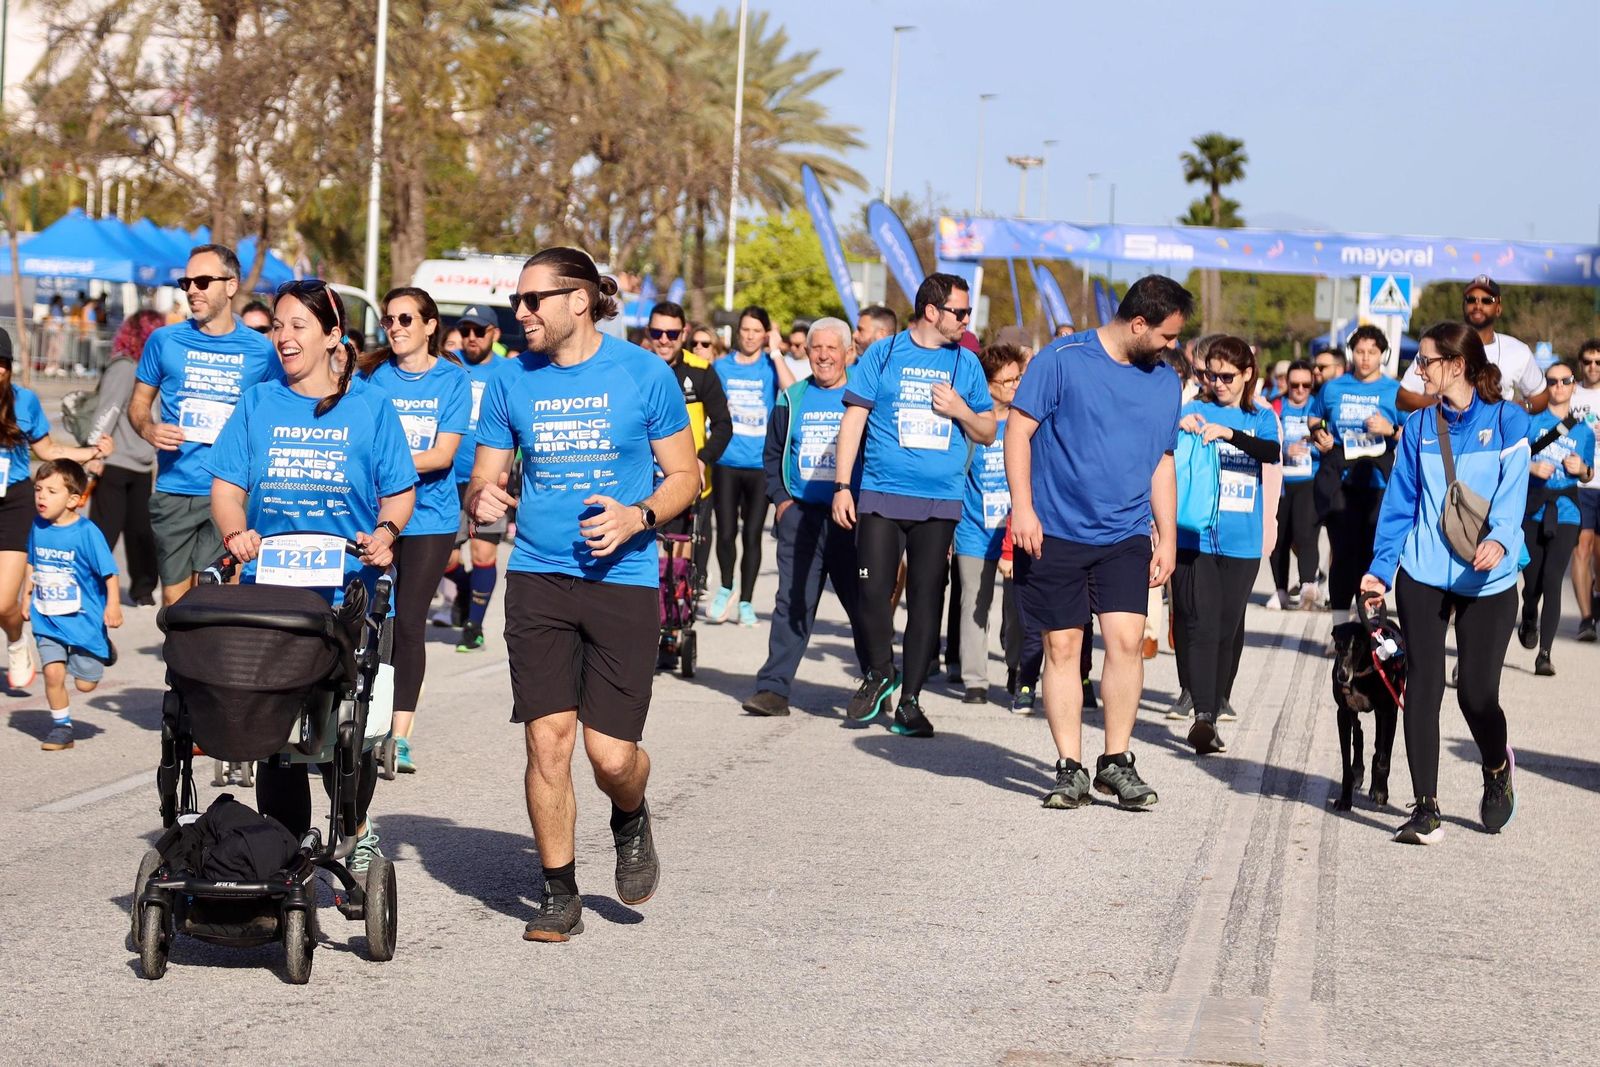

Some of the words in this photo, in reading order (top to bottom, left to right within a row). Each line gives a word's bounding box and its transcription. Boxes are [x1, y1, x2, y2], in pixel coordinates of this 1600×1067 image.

[1341, 246, 1434, 269] mayoral
[187, 350, 244, 365] mayoral
[903, 367, 950, 380] mayoral
[534, 393, 609, 414] mayoral
[533, 419, 607, 432] RUNNING
[273, 426, 349, 442] mayoral
[539, 430, 601, 442] MAKES
[268, 447, 344, 461] RUNNING
[273, 457, 336, 470] MAKES
[1221, 483, 1245, 497] 031
[276, 550, 327, 567] 1214
